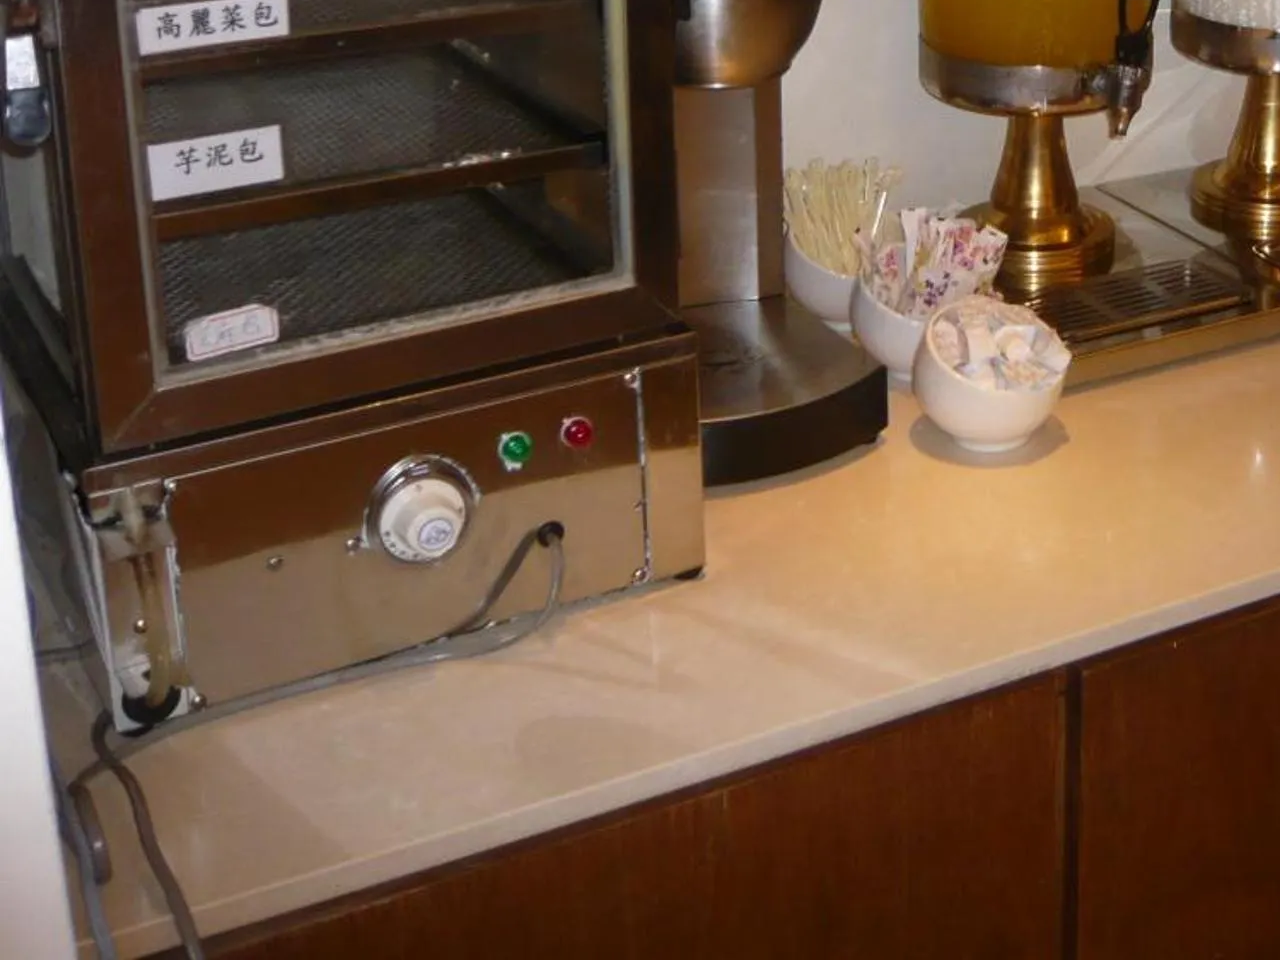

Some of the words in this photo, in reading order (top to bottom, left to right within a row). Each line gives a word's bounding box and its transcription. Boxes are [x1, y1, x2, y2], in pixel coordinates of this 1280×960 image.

[156, 1, 279, 40] 高麗菜包
[174, 137, 264, 175] 芋泥包
